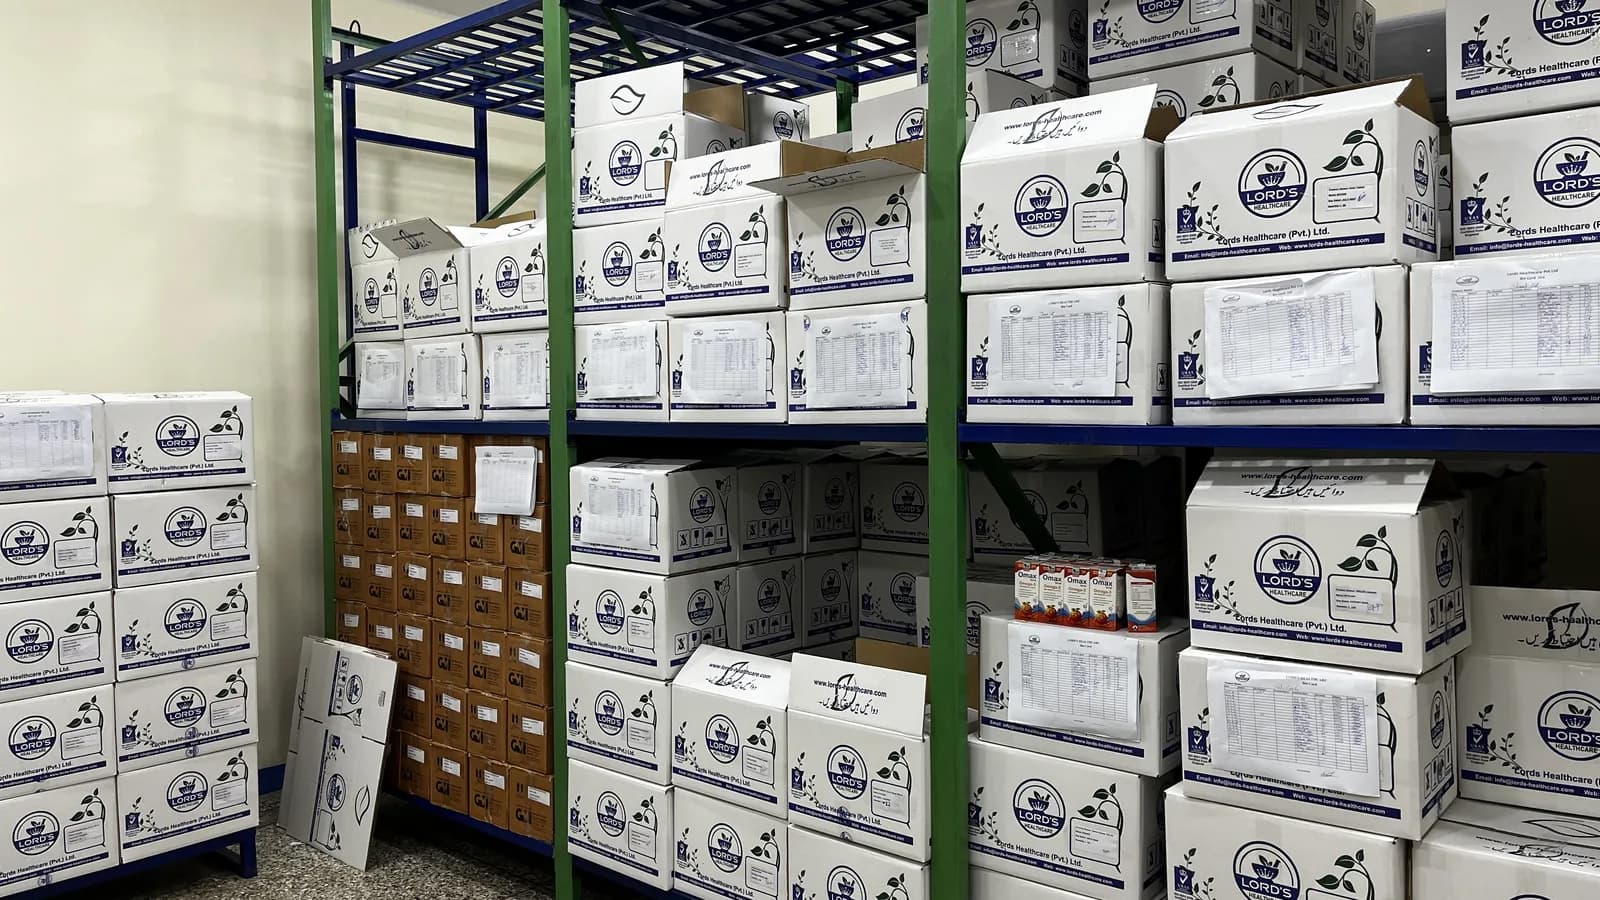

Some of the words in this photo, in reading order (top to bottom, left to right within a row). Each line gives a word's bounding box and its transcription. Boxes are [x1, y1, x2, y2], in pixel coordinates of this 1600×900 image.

[1139, 32, 1171, 44] Healthcare
[966, 44, 993, 56] ORD'S
[1539, 58, 1590, 73] Healthcare
[612, 166, 638, 176] LORD'S
[1543, 176, 1600, 192] LORD'S
[1246, 188, 1298, 203] LORD'S
[1551, 191, 1596, 201] HEALTHCARE
[1254, 201, 1291, 210] HEALTHCARE
[1020, 210, 1062, 223] LORD'S
[1539, 221, 1591, 235] Healthcare
[1243, 232, 1287, 243] Healthcare
[1288, 228, 1311, 240] (Pvt.)
[829, 238, 862, 249] LORD'S
[701, 251, 728, 260] LORD'S
[1017, 250, 1053, 259] Healthcare
[1053, 248, 1072, 258] (Pvt.)
[161, 439, 195, 447] LORD'S
[169, 530, 202, 538] LORD'S
[6, 546, 45, 556] LORD'S
[1017, 571, 1037, 579] Omax
[1042, 574, 1062, 582] Omax
[1067, 576, 1087, 585] Omax
[1092, 579, 1113, 587] Omax
[1262, 575, 1313, 588] LORD'S
[1269, 589, 1307, 598] HEALTHCARE
[599, 614, 622, 625] LORD'S
[1259, 616, 1304, 628] Healthcare
[1305, 621, 1328, 631] (Pvt.)
[169, 621, 202, 631] LORD'S
[11, 643, 49, 655] LORD'S
[169, 708, 202, 720] LORD'S
[597, 715, 623, 726] LORD'S
[14, 740, 51, 752] LORD'S
[709, 741, 736, 754] LORD'S
[1555, 743, 1598, 753] HEALTHCARE
[831, 773, 863, 789] LORD'S
[1543, 771, 1592, 785] Healthcare
[172, 792, 204, 806] LORD'S
[600, 815, 623, 829] LORD'S
[1018, 810, 1060, 827] LORD'S
[18, 834, 55, 848] LORD'S
[712, 849, 738, 864] LORD'S
[1015, 844, 1050, 859] Healthcare
[1050, 852, 1069, 865] (Pvt.)
[1241, 877, 1292, 898] LORD'S
